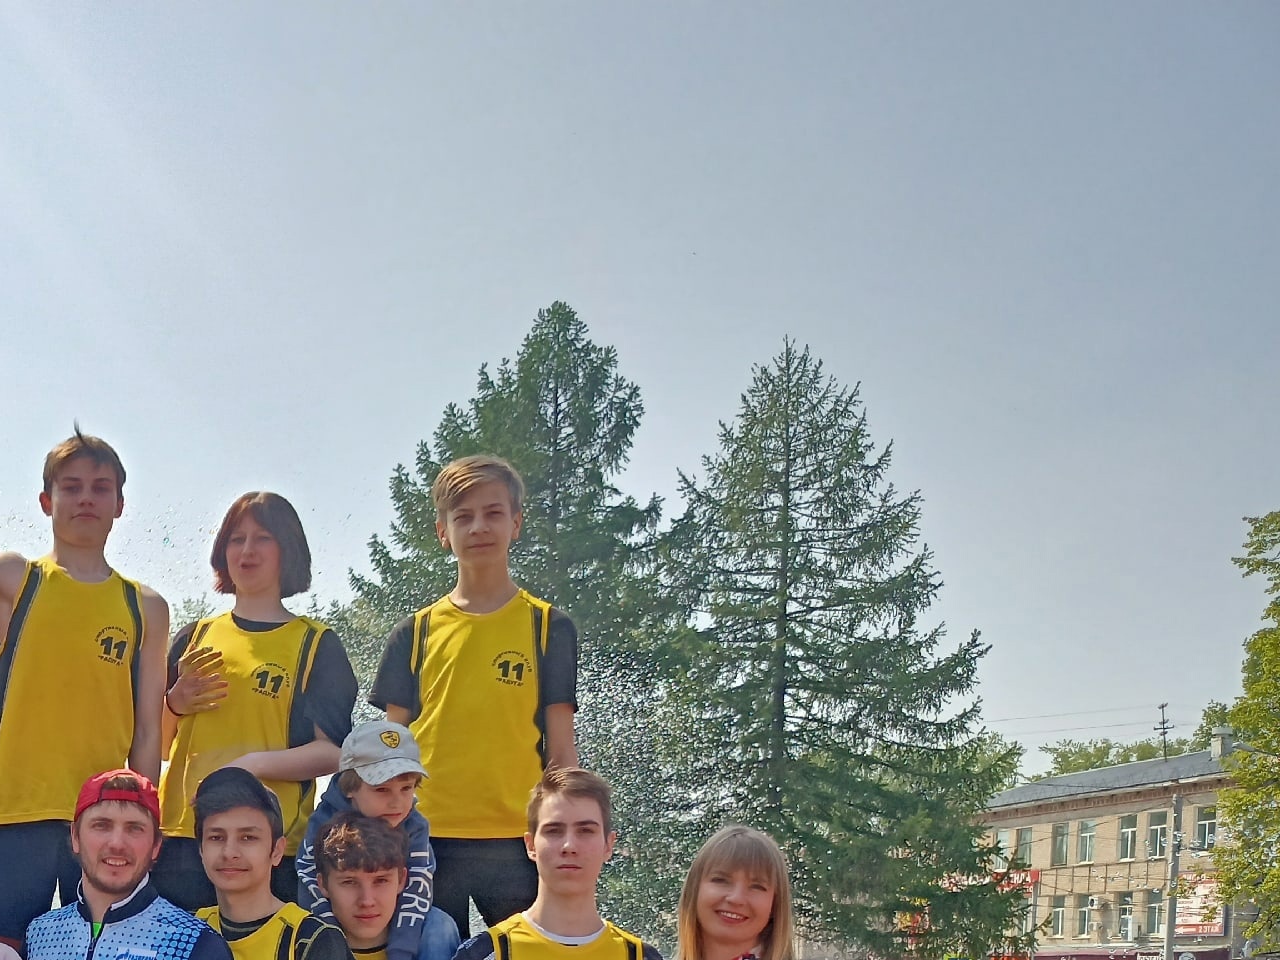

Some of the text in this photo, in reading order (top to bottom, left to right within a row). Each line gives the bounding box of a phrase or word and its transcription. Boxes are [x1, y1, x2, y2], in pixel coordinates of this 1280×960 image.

[100, 636, 127, 660] 11
[256, 670, 284, 694] 11
[498, 660, 524, 682] 11
